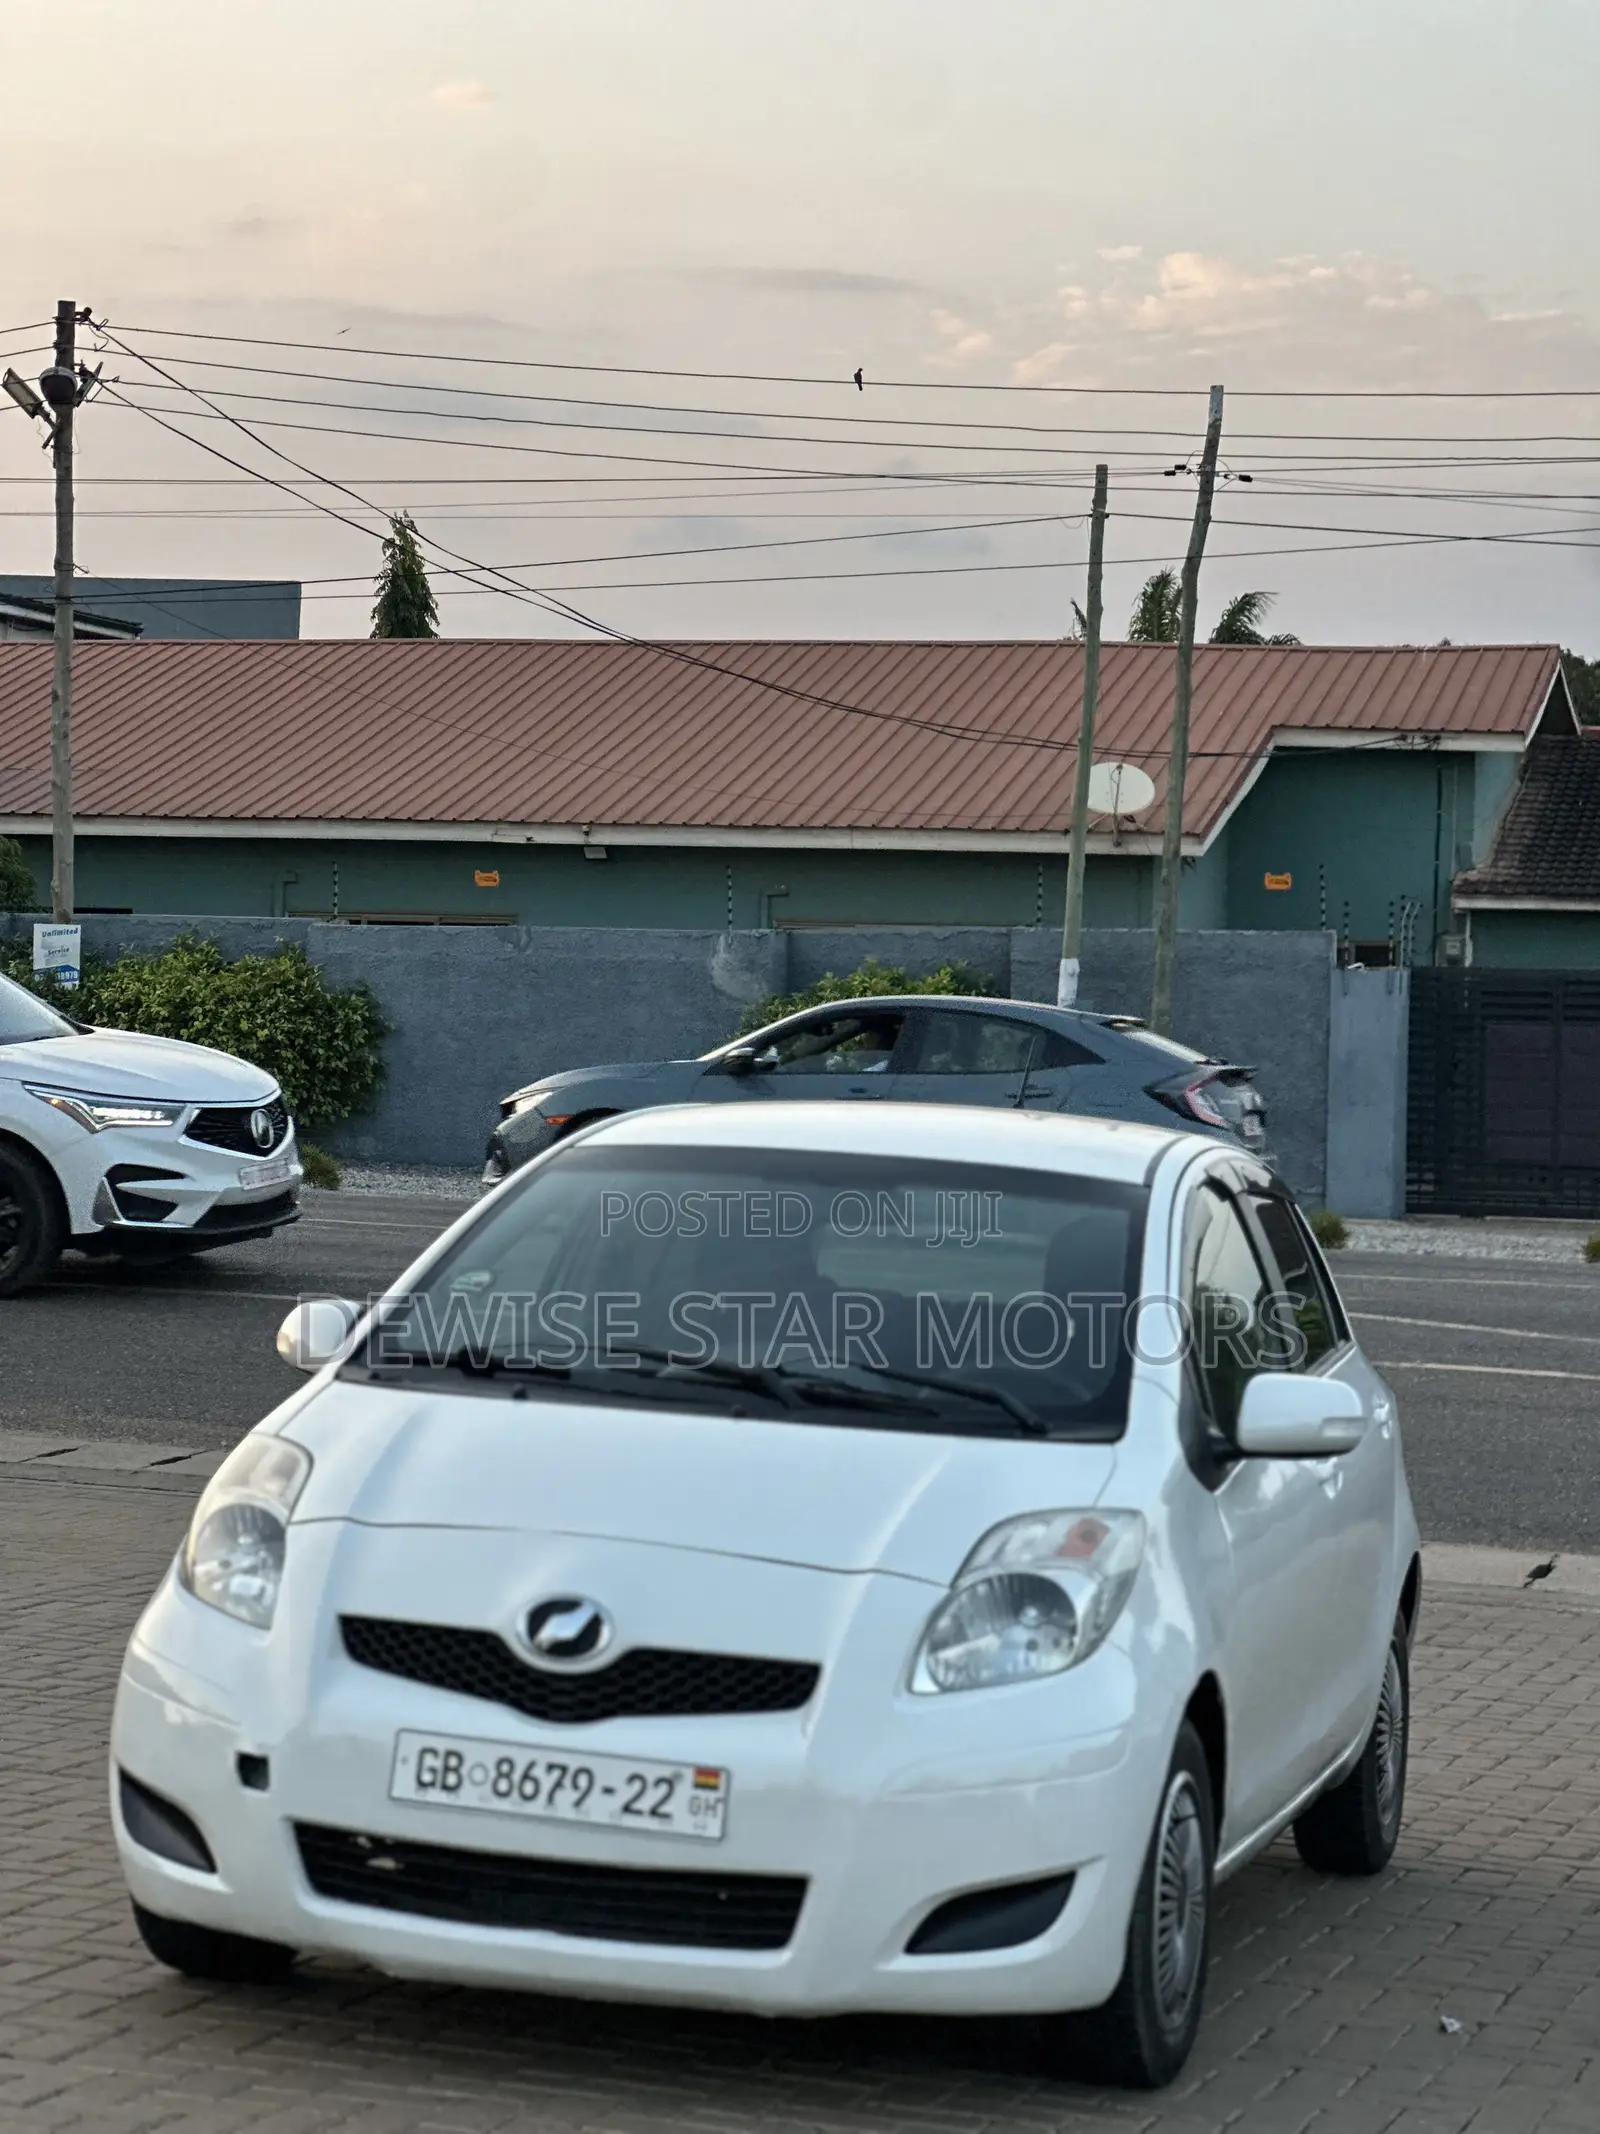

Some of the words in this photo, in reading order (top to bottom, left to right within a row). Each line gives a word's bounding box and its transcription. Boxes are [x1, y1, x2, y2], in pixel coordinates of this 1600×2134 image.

[42, 928, 79, 937] Unlimited
[415, 1746, 464, 1792] GB
[491, 1756, 676, 1820] 8679-22
[688, 1794, 719, 1819] GH
